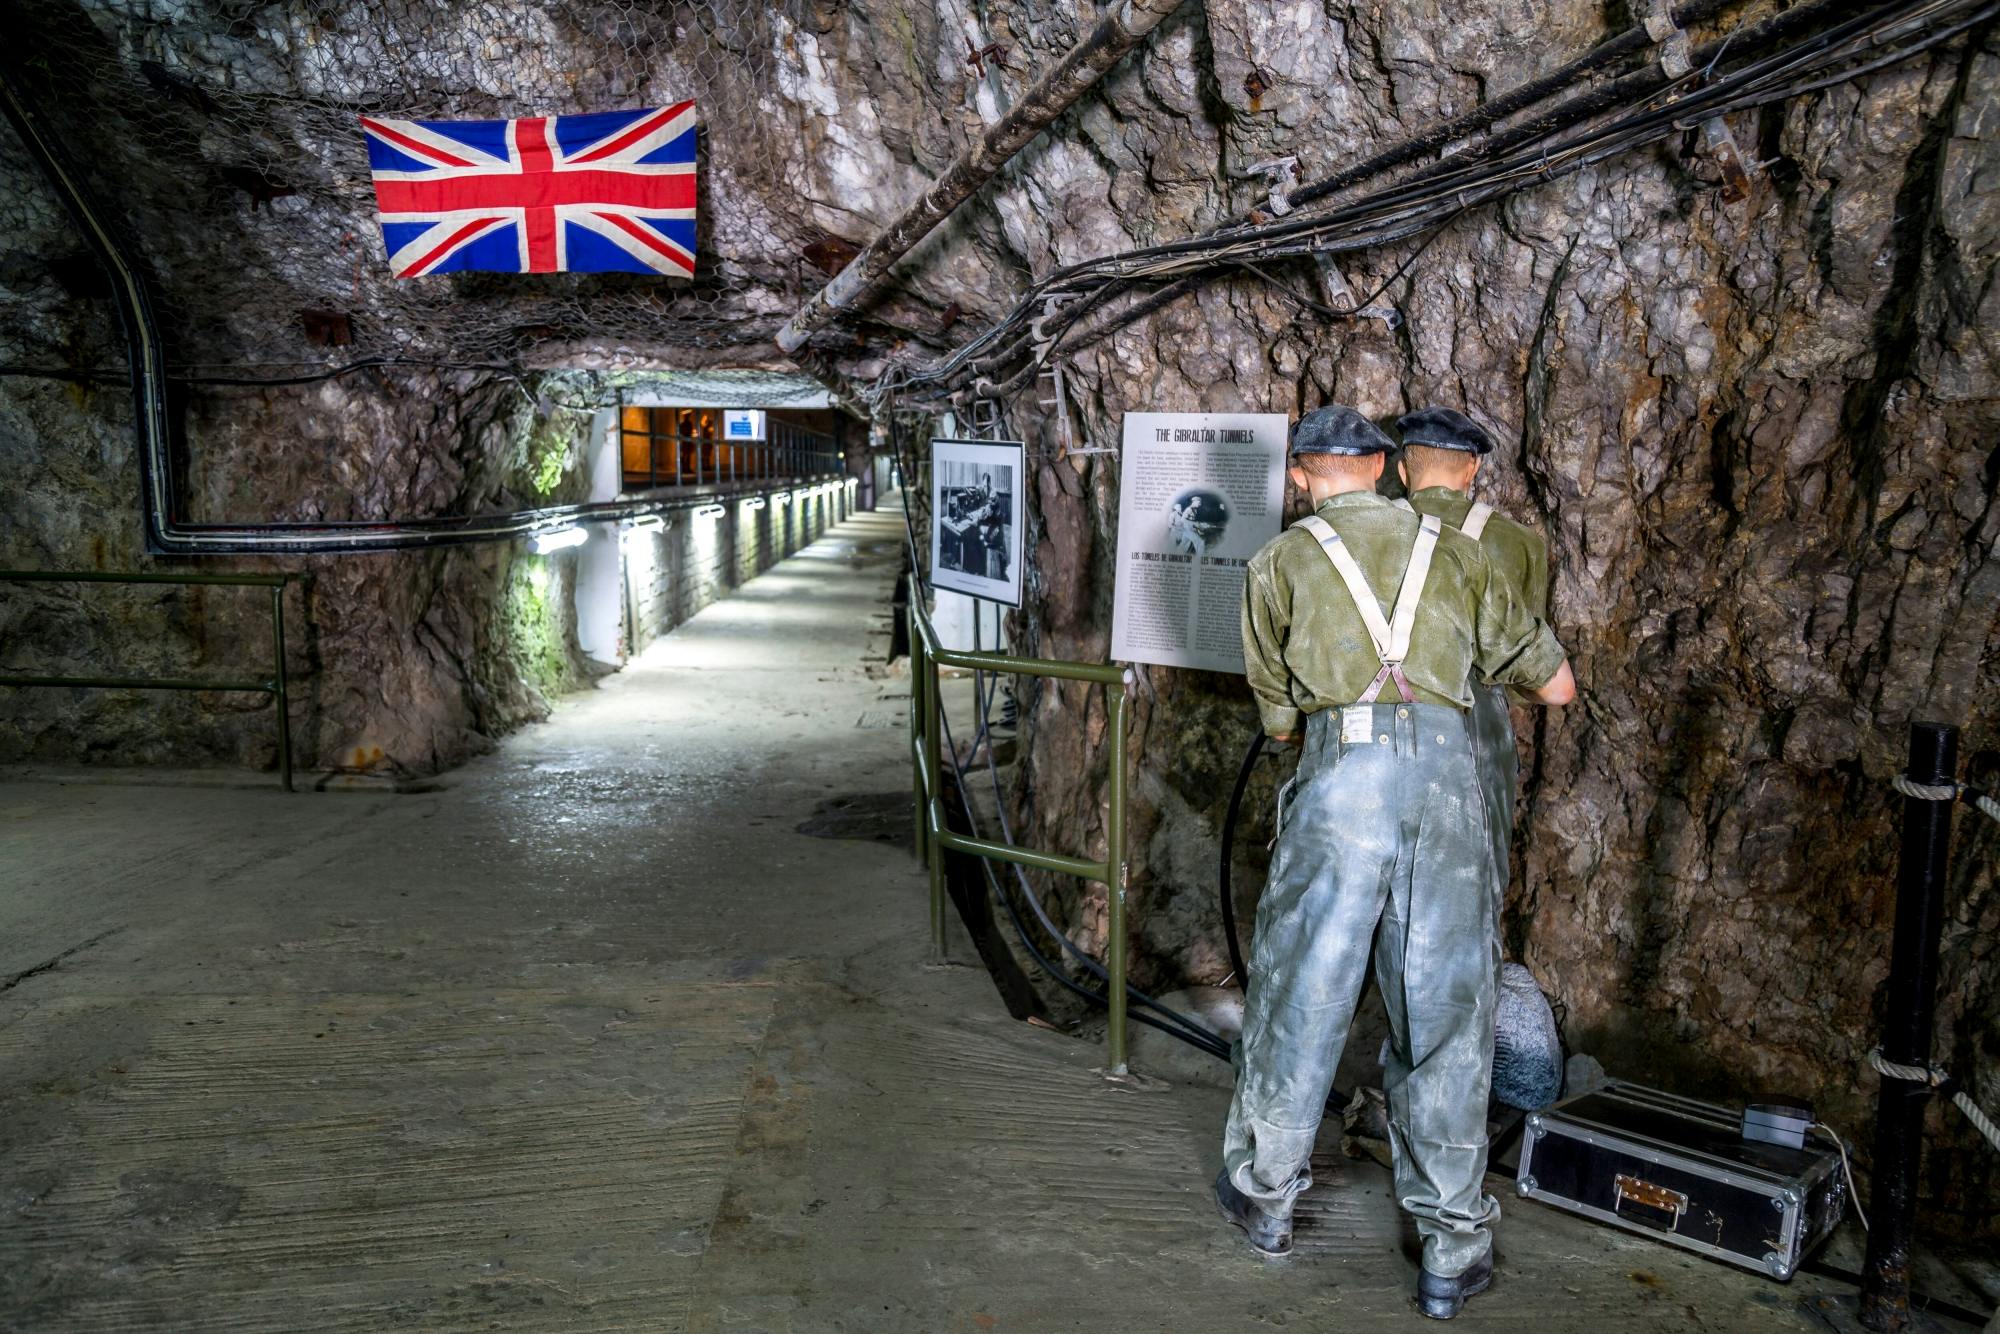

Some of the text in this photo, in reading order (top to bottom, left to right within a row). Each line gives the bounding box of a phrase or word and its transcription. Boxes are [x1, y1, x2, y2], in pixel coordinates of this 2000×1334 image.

[1155, 427, 1254, 444] THE GIBRALTAR TUNNELS
